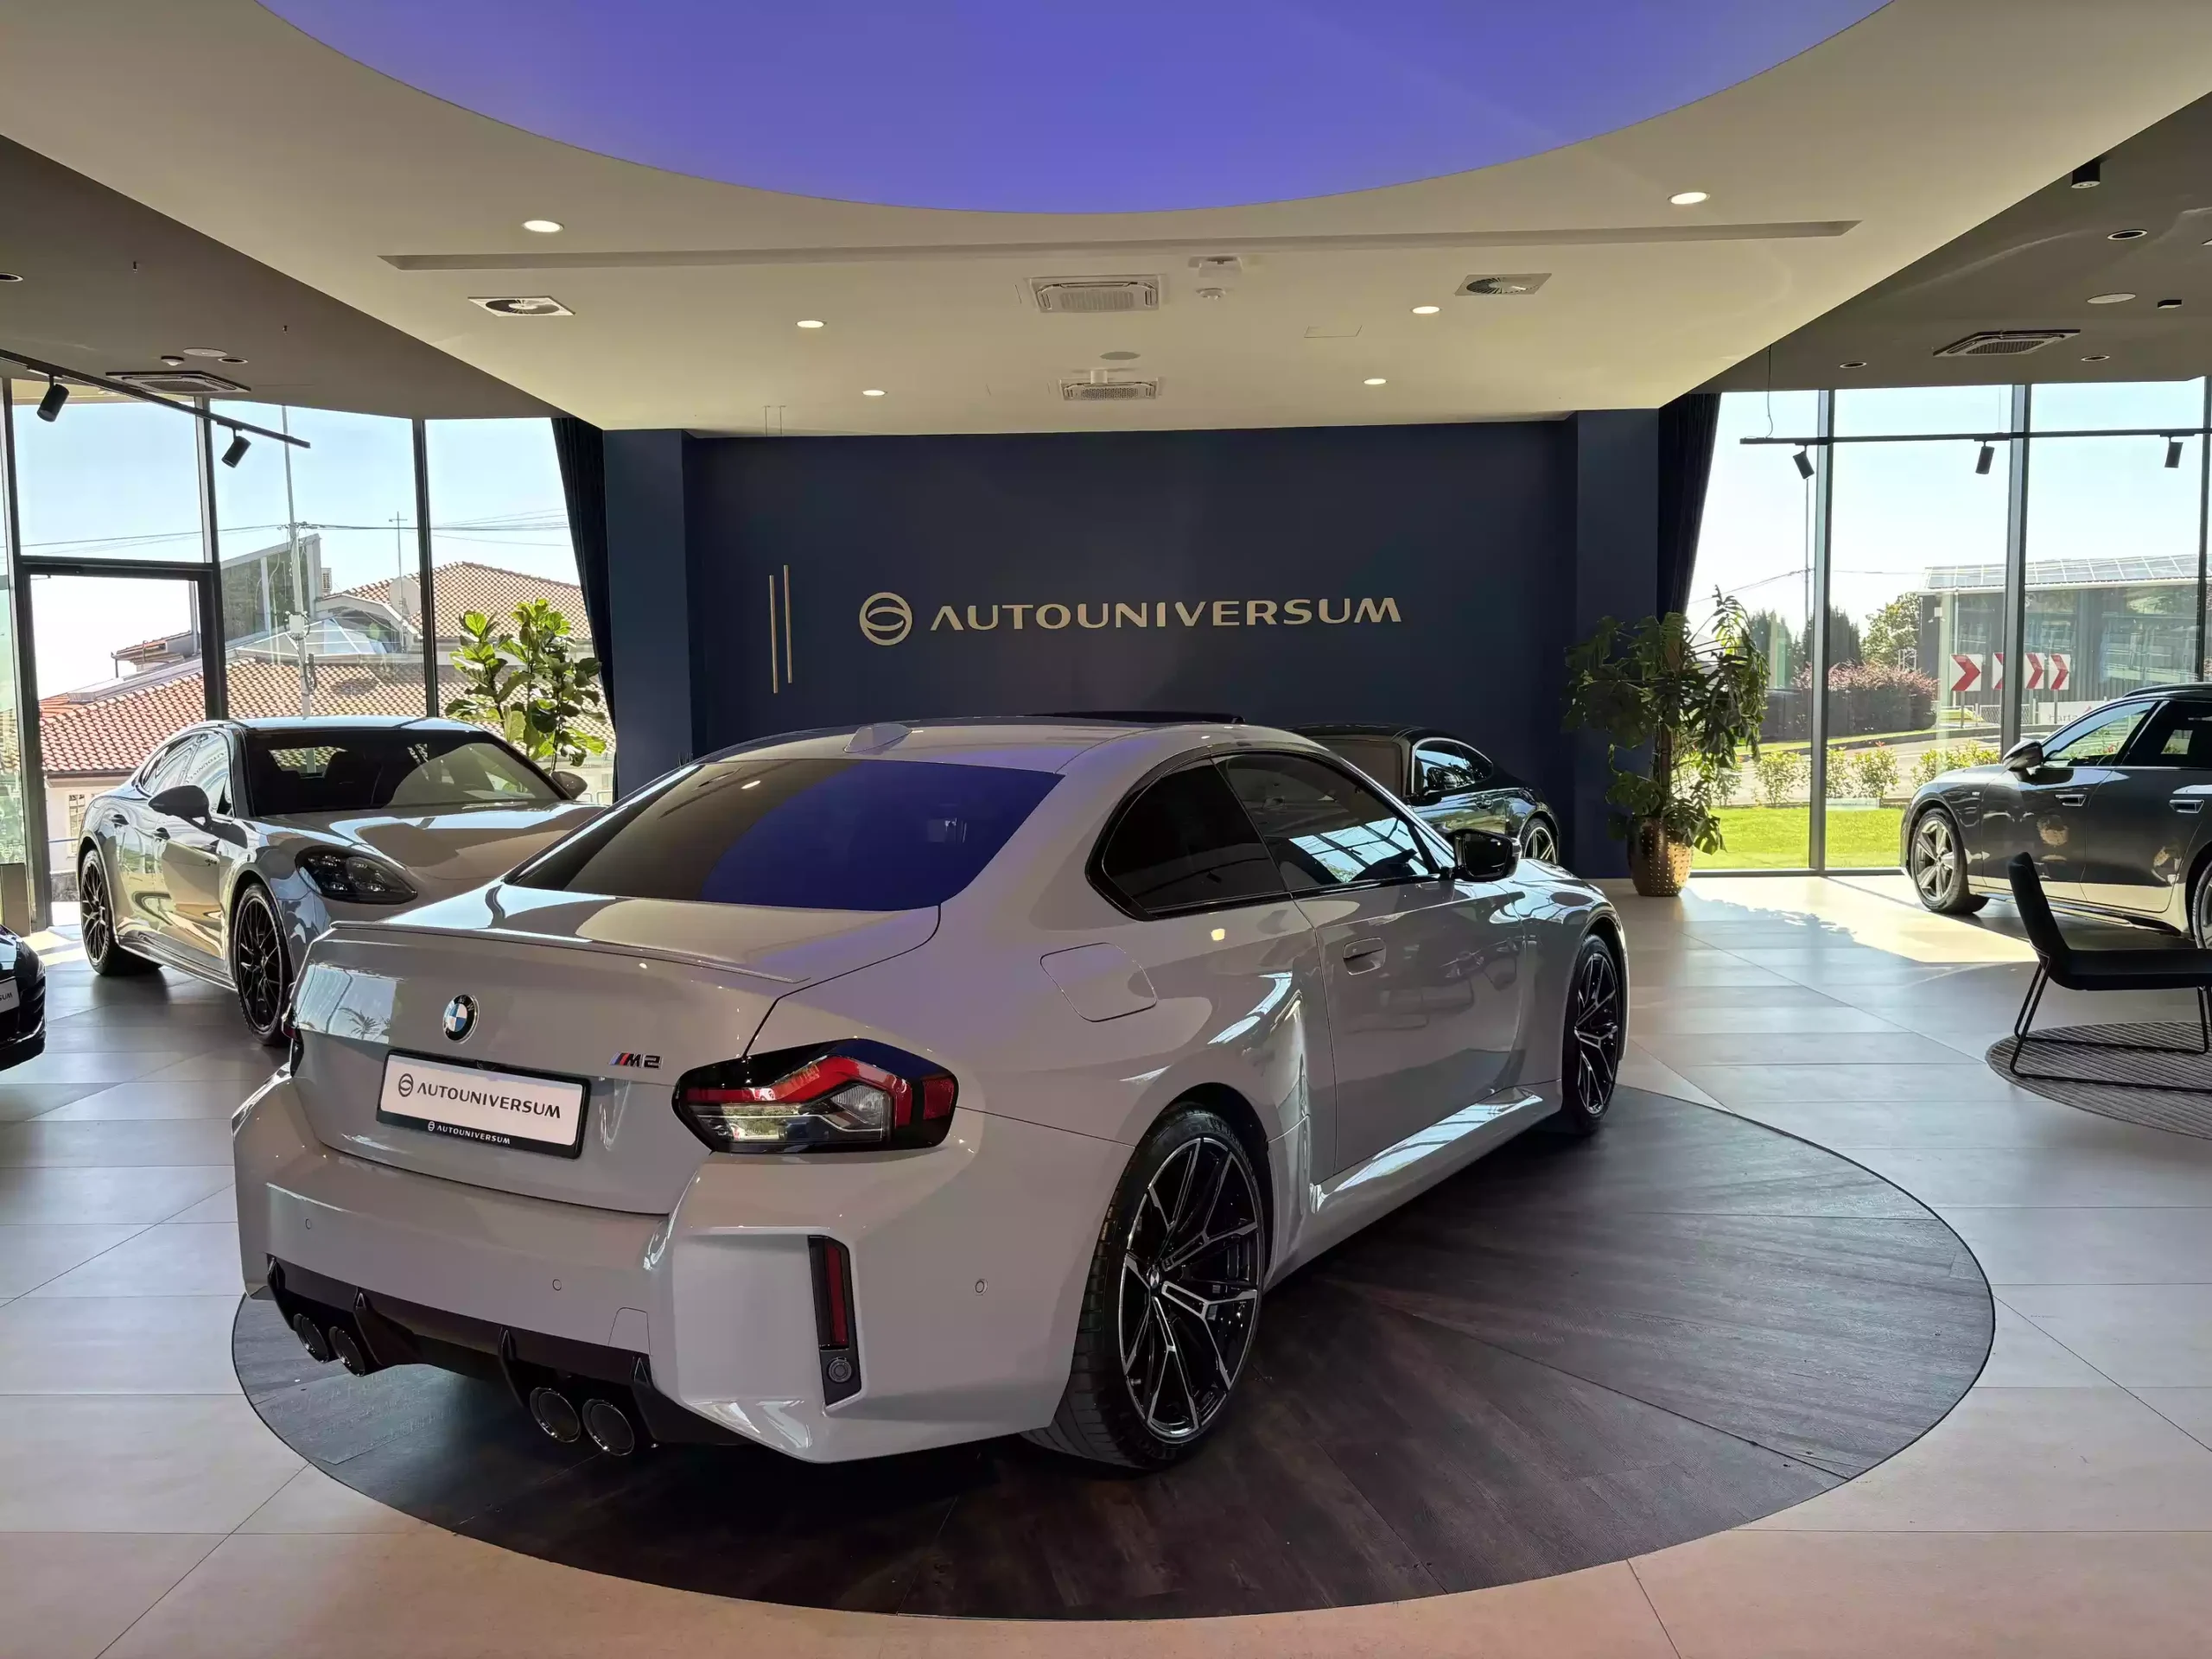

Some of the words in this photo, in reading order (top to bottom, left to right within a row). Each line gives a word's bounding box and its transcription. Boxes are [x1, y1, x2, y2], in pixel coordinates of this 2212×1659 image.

[930, 597, 1402, 630] AUTOUNIVERSUM
[621, 1052, 662, 1069] M2
[417, 1082, 561, 1118] AUTOUNIVERSUM
[437, 1125, 511, 1145] AUTOUNIVERSUM
